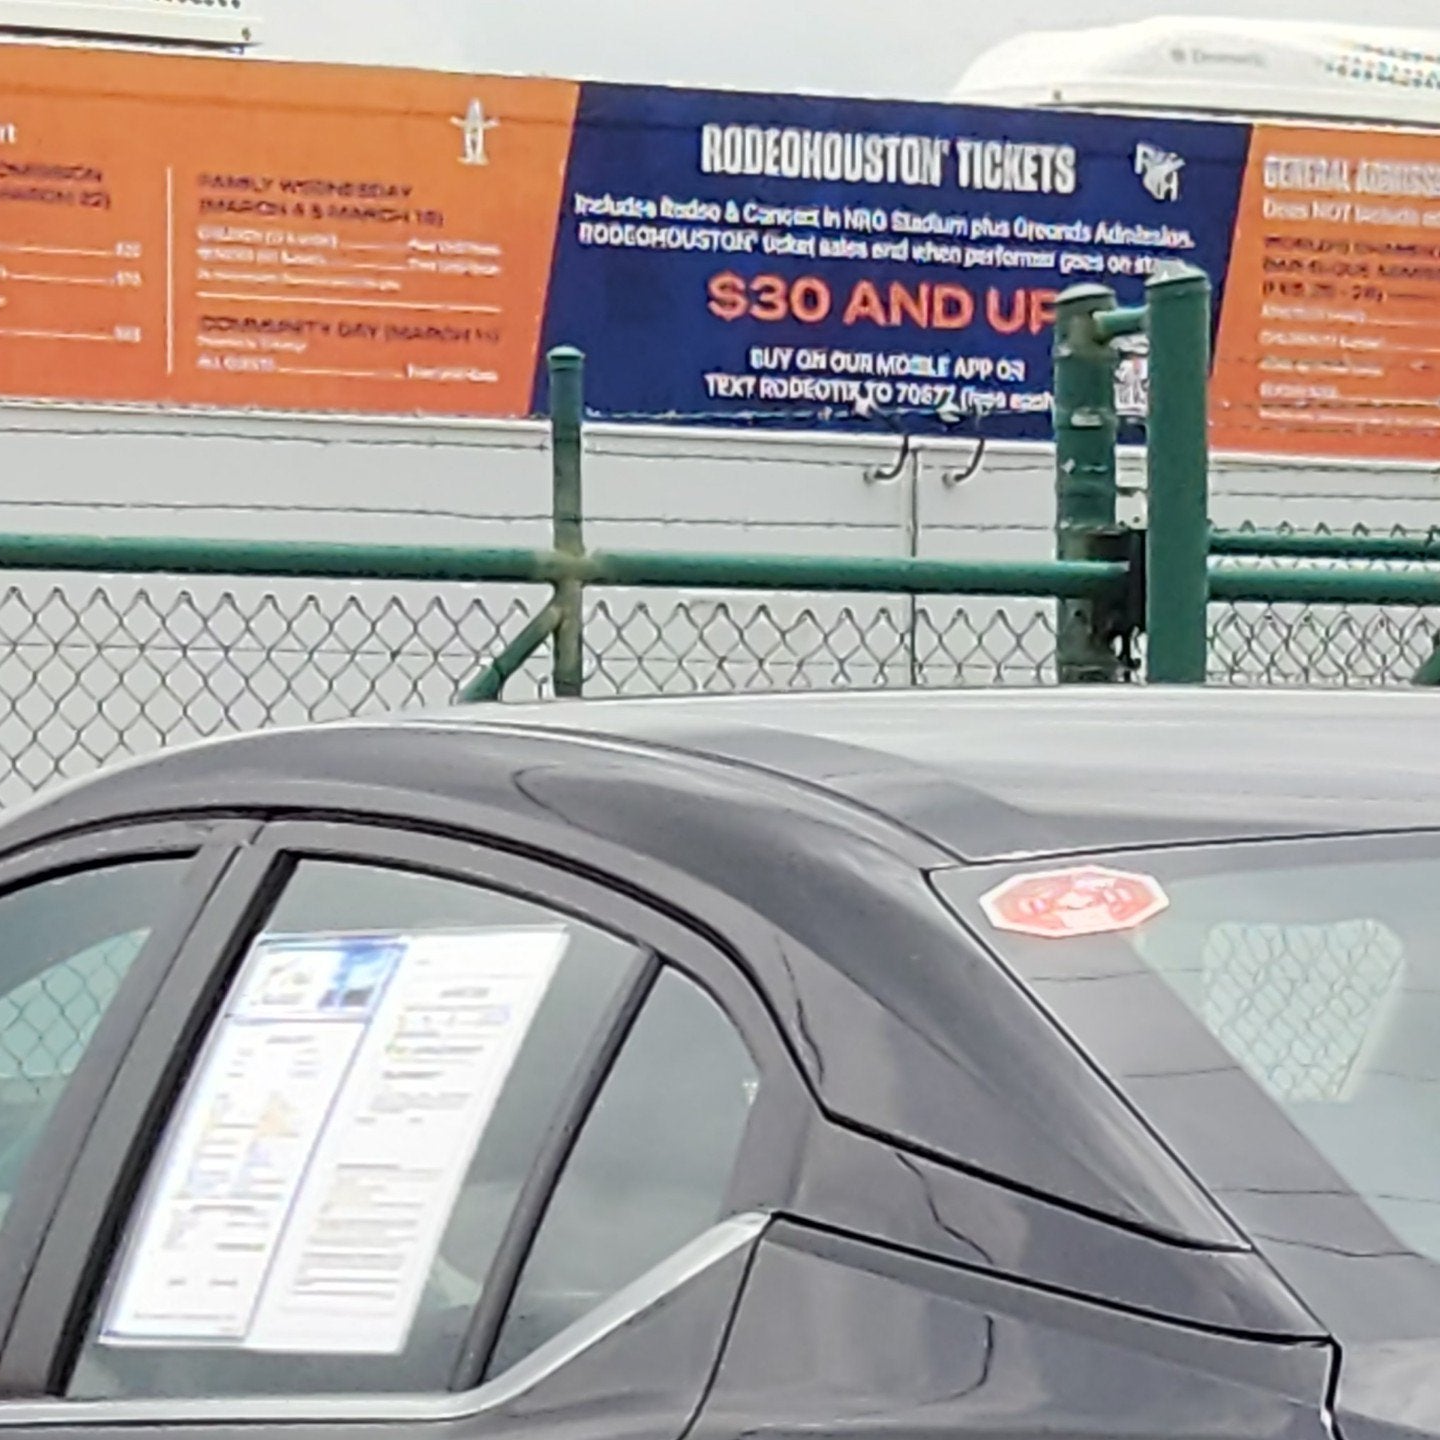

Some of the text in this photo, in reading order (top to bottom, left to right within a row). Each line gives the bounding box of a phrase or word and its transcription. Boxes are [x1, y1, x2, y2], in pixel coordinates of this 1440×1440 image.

[955, 136, 1077, 193] TICKETS
[725, 200, 739, 223] &
[707, 271, 1058, 335] $30 AND UP
[749, 347, 793, 370] BUY
[830, 352, 873, 374] OUR
[704, 372, 757, 397] TEXT
[864, 379, 893, 402] TO
